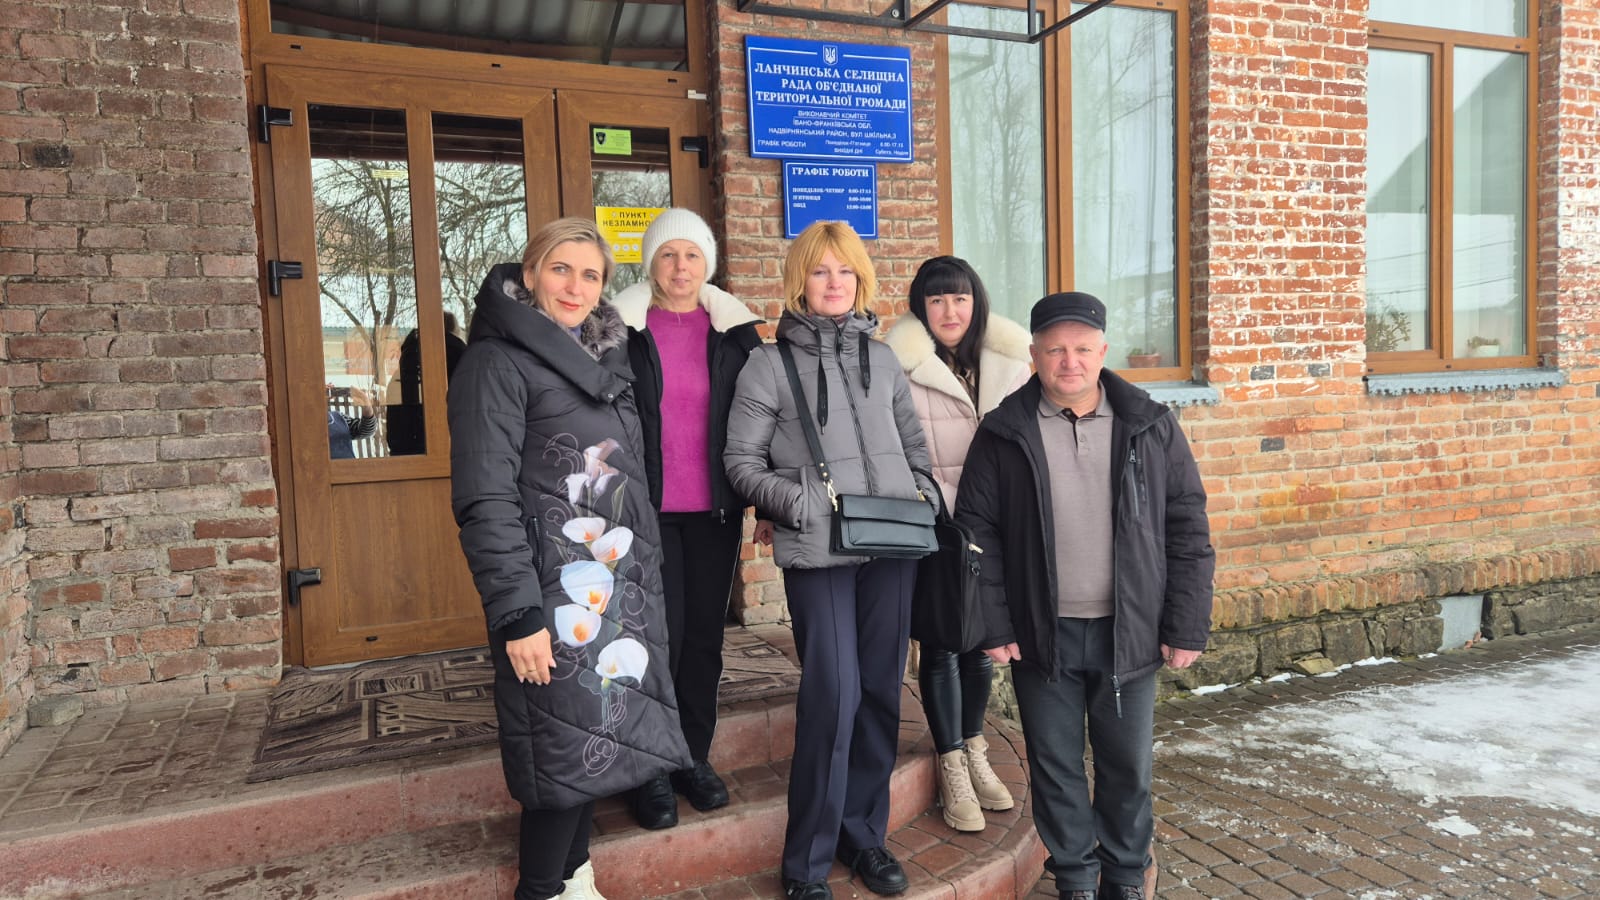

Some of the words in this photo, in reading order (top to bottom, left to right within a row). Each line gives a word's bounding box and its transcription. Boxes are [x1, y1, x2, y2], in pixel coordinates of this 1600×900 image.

[755, 63, 840, 78] ЛАНЧИНСЬКА
[844, 70, 904, 83] СЕЛИЩНА
[781, 79, 812, 91] РАДА
[815, 81, 881, 94] ОБ'ЄДНАНОЇ
[755, 91, 852, 106] ТЕРИТОРІАЛЬНОЇ
[855, 97, 906, 110] ГРОМАДИ
[798, 110, 840, 119] ВИКОНАВЧИЙ
[793, 119, 857, 129] ІВАНО-ФРАНКІВСЬКА
[768, 127, 825, 136] НАДВІРНЯНСЬКИЙ
[781, 140, 806, 148] РОБОТИ
[792, 167, 829, 176] ГРАФІК
[832, 168, 869, 177] РОБОТИ
